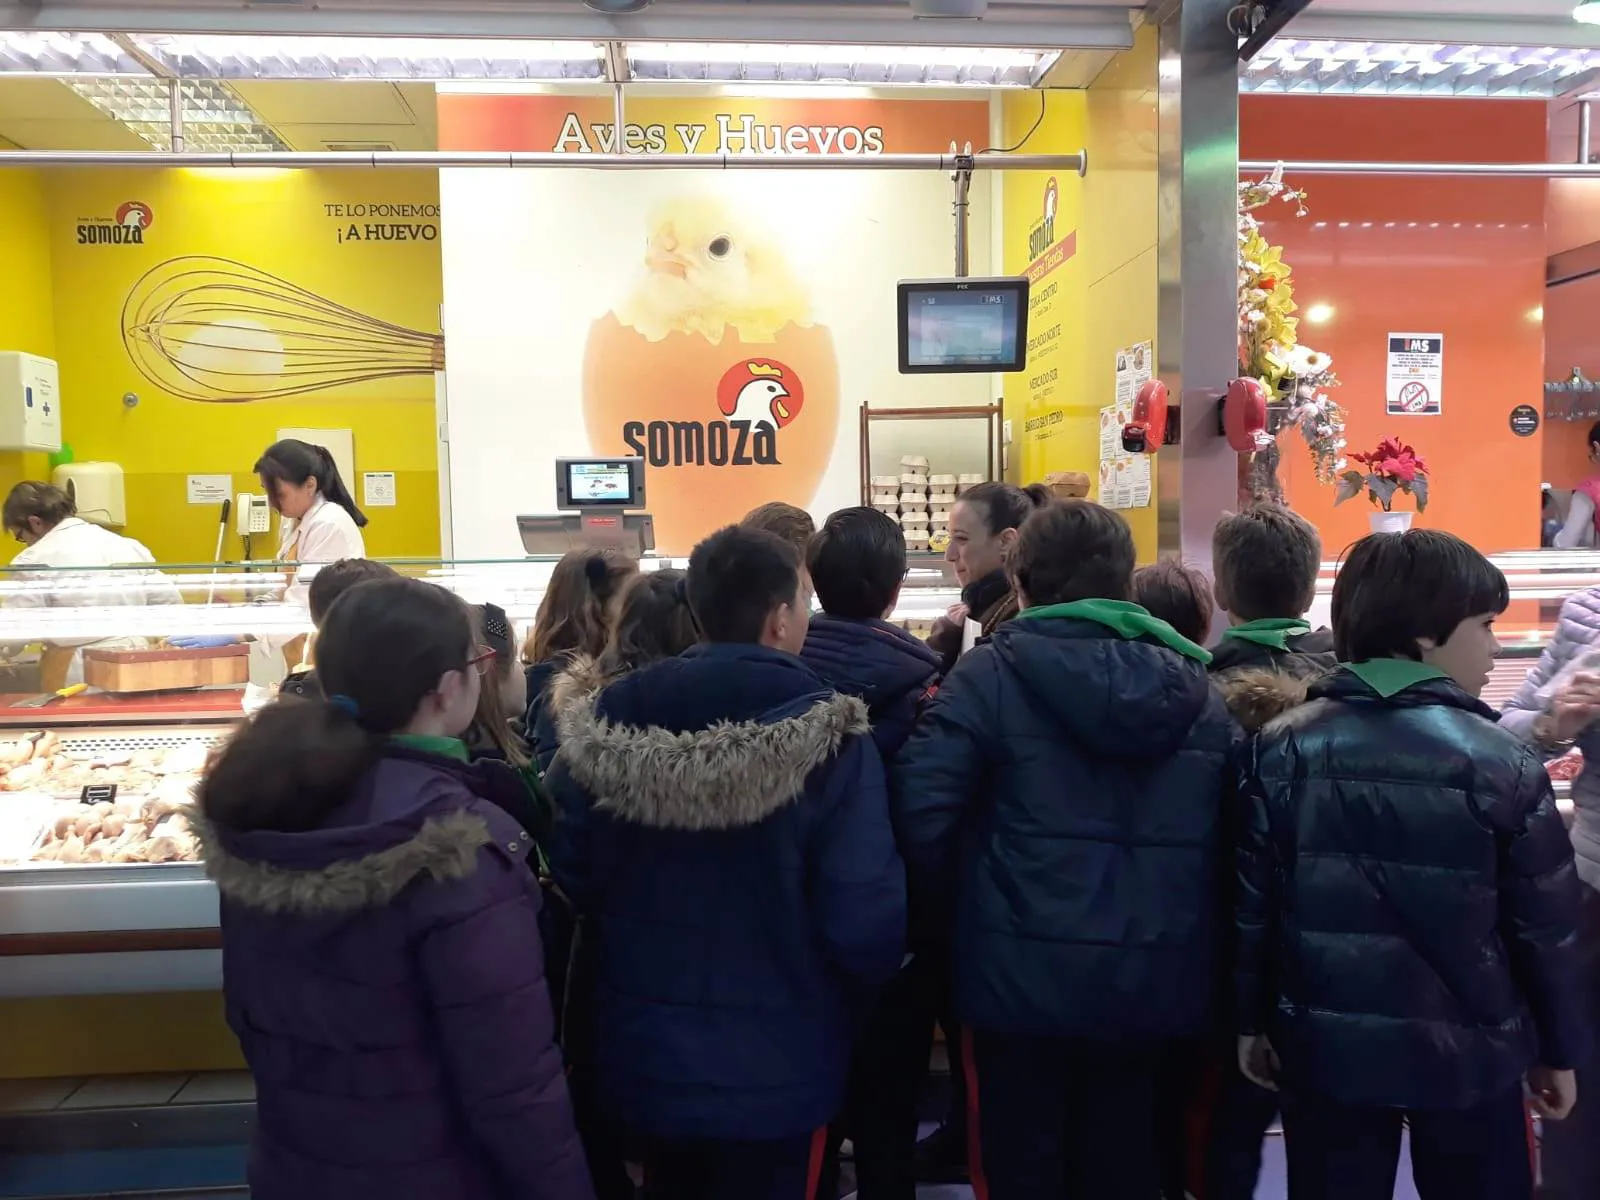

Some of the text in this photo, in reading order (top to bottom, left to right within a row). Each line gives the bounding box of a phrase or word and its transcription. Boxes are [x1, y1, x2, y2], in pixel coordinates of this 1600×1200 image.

[553, 112, 884, 154] Aves y Huevos
[324, 204, 343, 217] TE
[346, 204, 366, 217] LO
[364, 223, 437, 241] HUEVO
